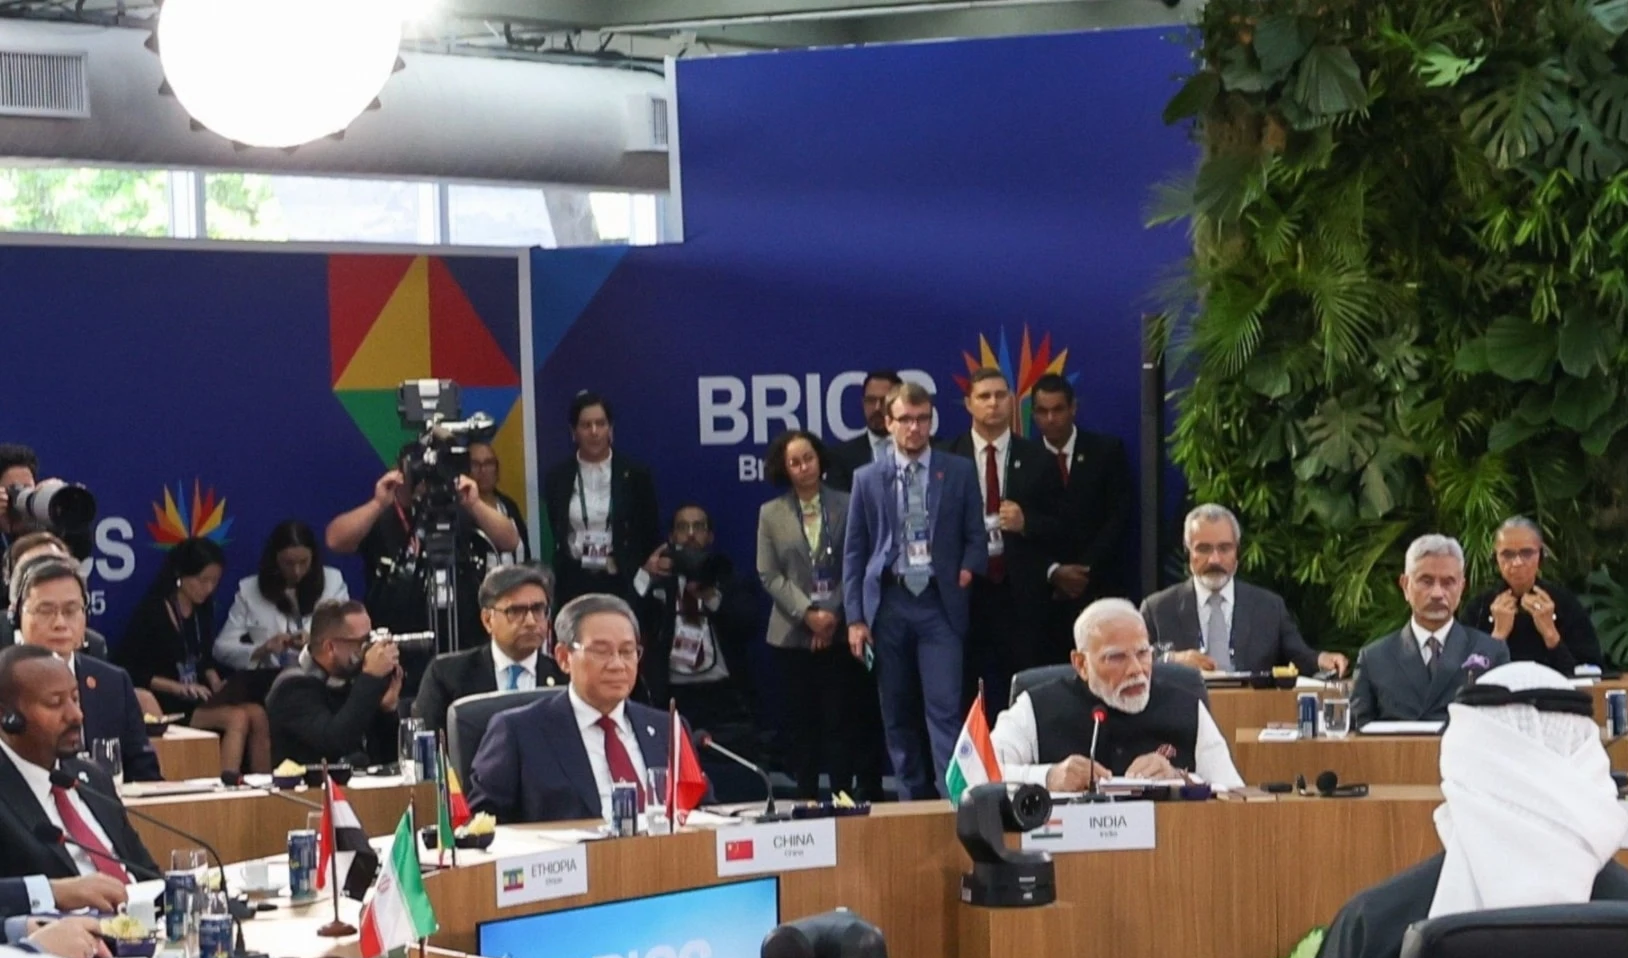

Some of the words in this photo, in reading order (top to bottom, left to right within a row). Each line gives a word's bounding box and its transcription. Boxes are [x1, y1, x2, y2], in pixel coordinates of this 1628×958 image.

[1088, 815, 1128, 829] INDIA
[773, 832, 815, 849] CHINA
[531, 858, 577, 878] ETHIOPIA
